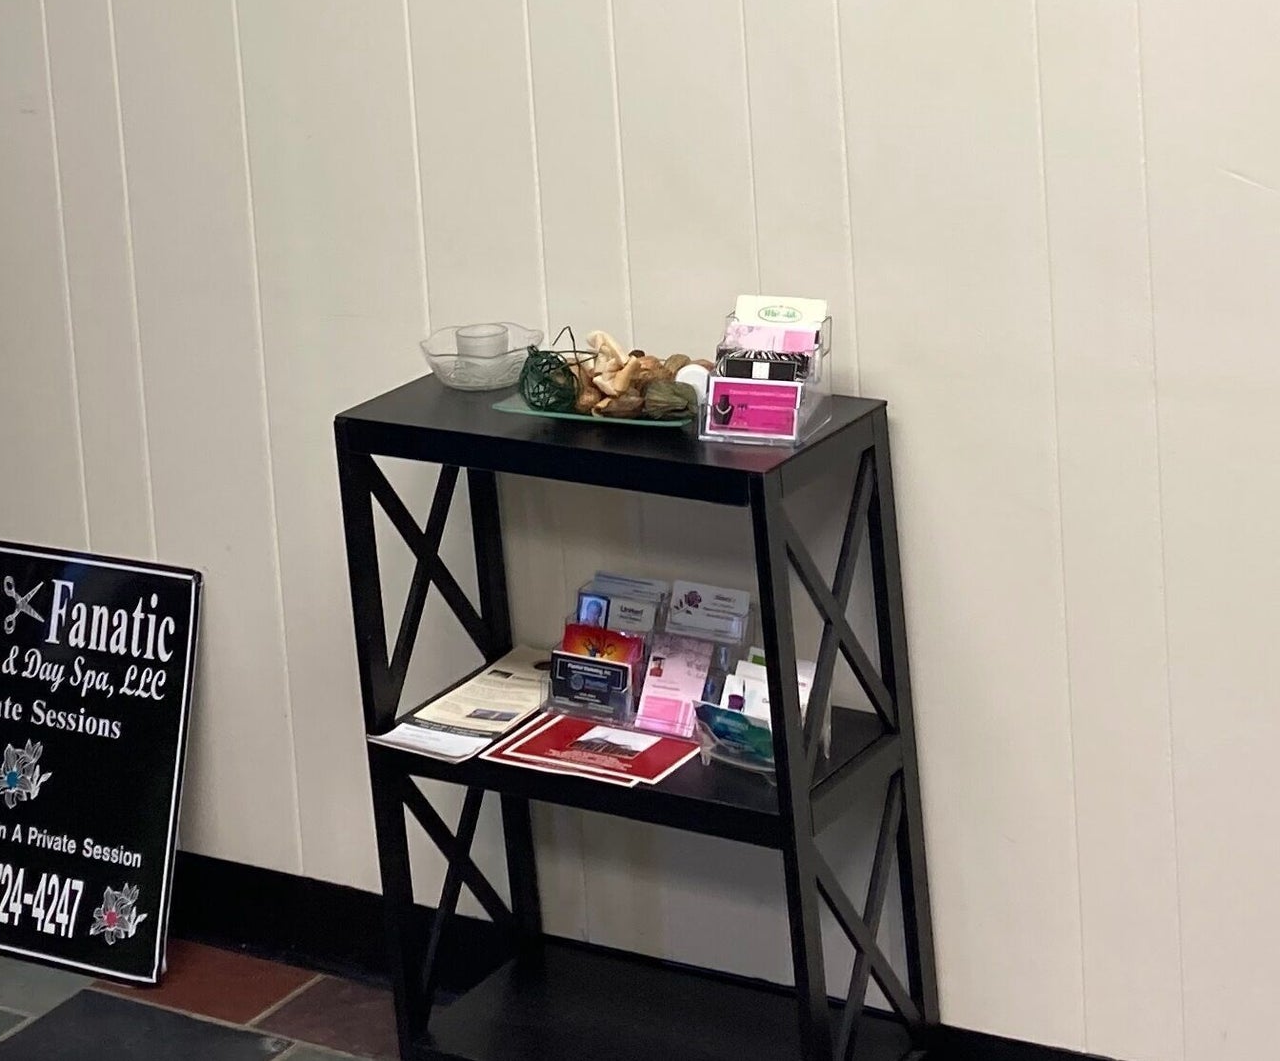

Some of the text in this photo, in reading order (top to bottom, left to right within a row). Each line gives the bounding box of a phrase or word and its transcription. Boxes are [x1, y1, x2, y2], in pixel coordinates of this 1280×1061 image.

[44, 578, 176, 663] Fanatic
[1, 645, 20, 676] &
[21, 647, 66, 693] Day
[69, 655, 114, 699] Spa,
[119, 664, 167, 701] LLC
[30, 699, 122, 740] Sessions
[11, 823, 23, 843] A
[27, 826, 77, 855] Private
[81, 837, 142, 868] Session
